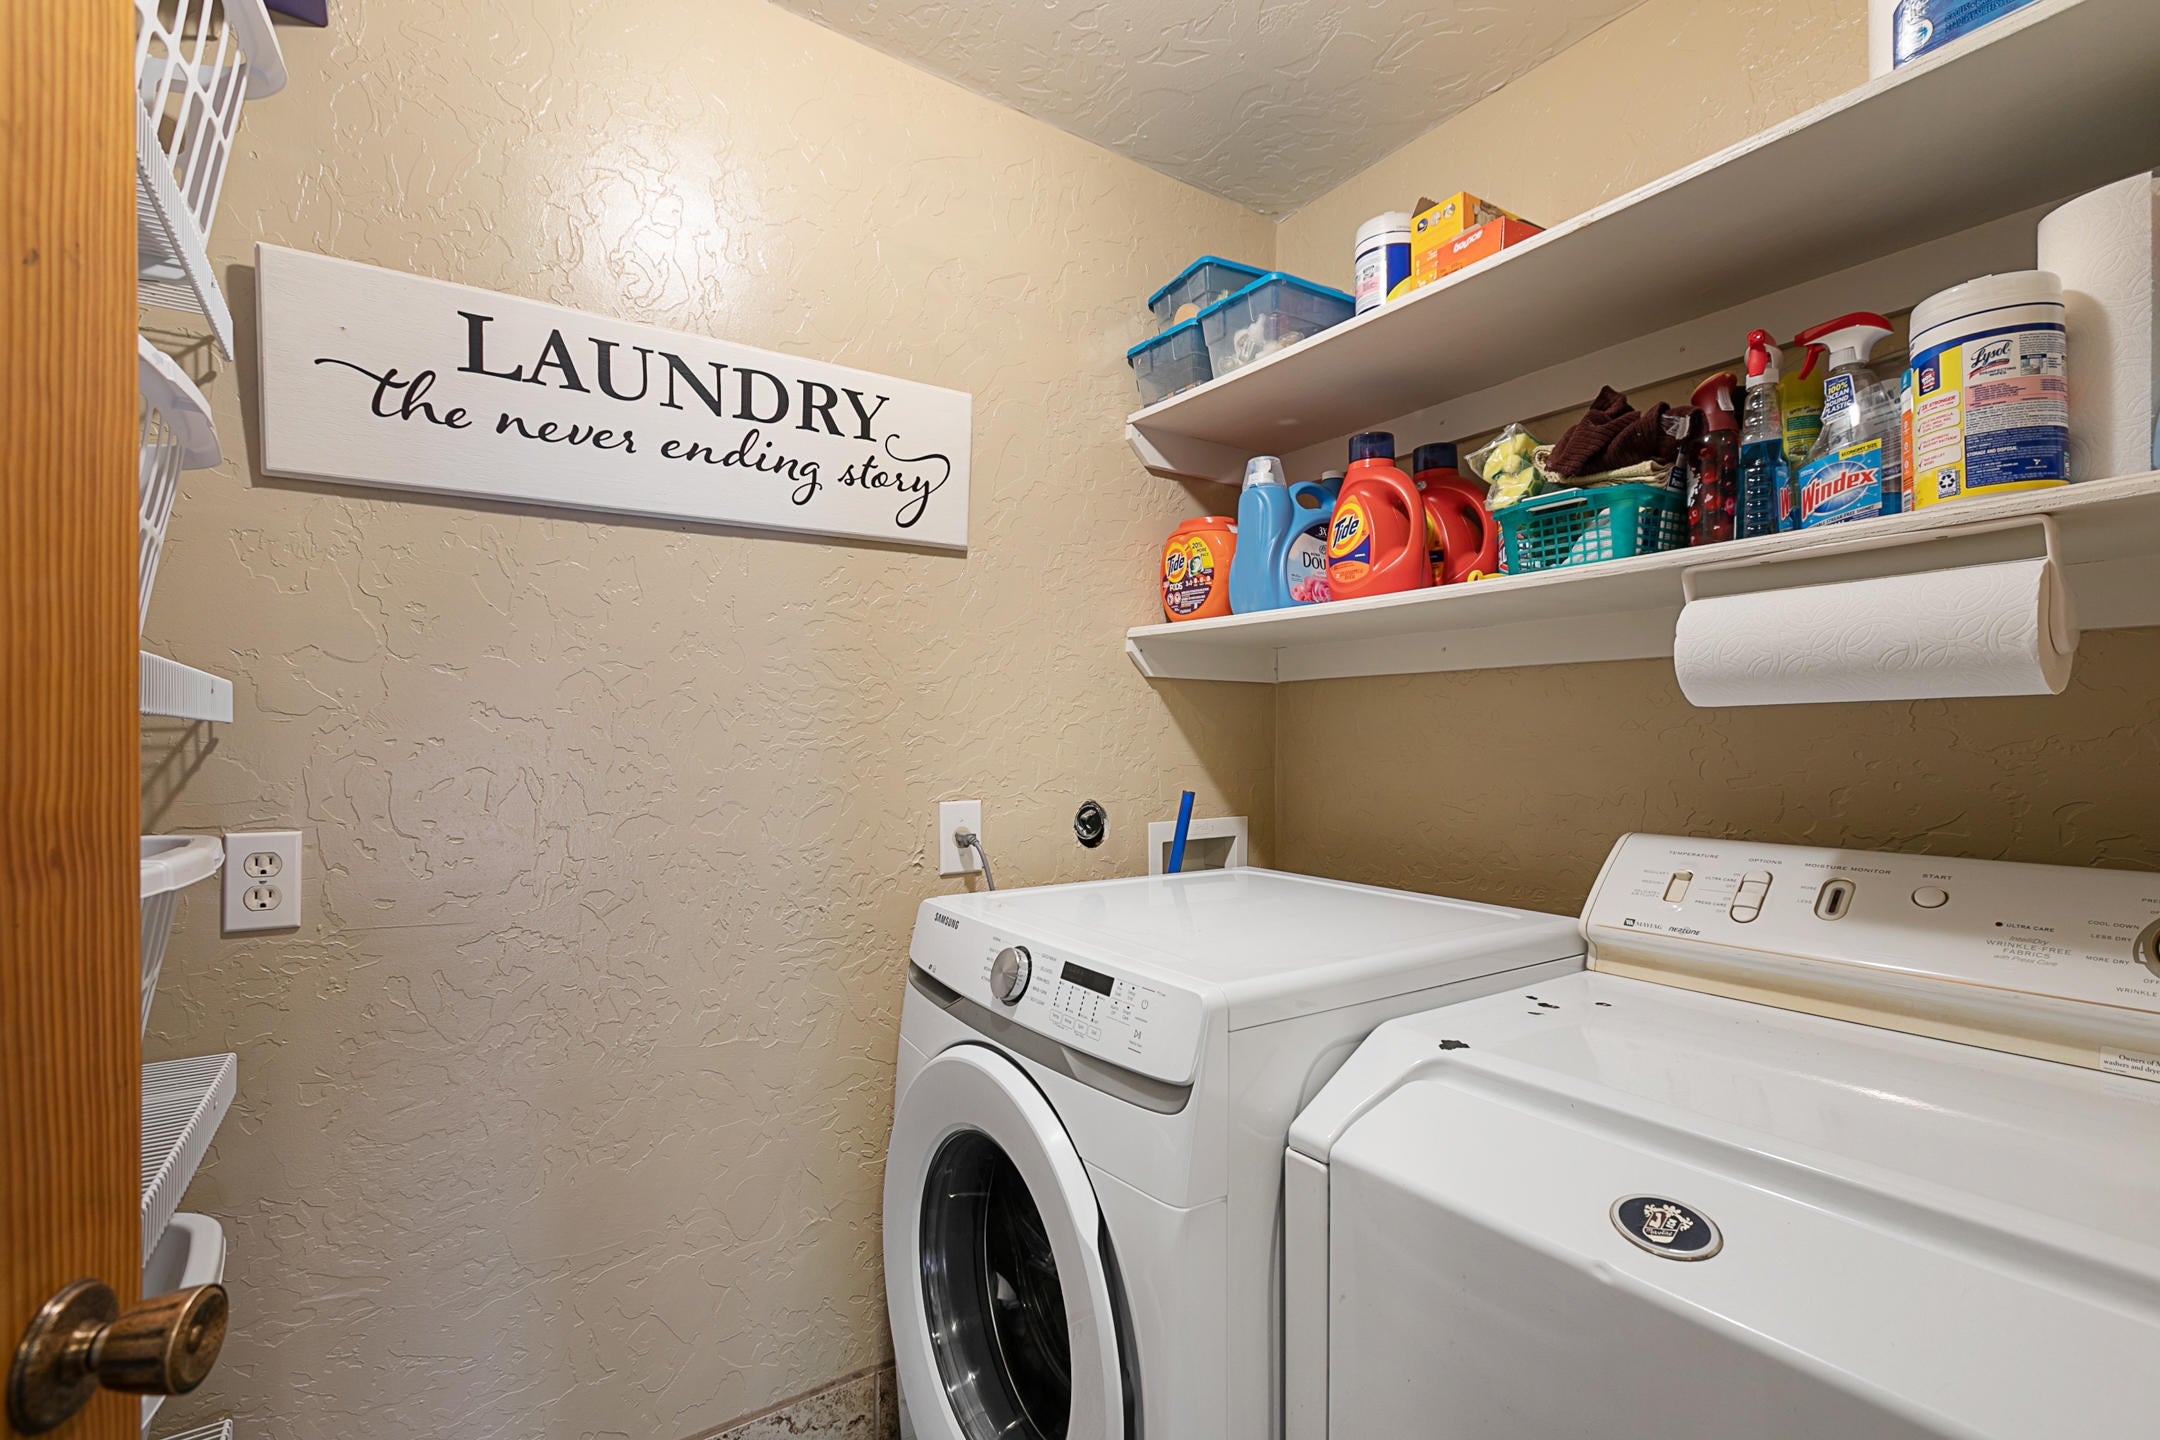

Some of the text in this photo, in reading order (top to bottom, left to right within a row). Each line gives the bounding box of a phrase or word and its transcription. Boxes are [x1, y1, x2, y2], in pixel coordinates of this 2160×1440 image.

[1971, 340, 2012, 368] Lysol
[457, 311, 890, 443] LAUNDRY
[1828, 380, 1848, 394] 100%
[1827, 388, 1850, 402] OCEAN
[314, 357, 951, 529] the never ending story
[1801, 470, 1878, 522] Windex
[1333, 516, 1360, 549] Tide
[1167, 553, 1185, 578] Tide
[1669, 850, 1720, 859] TEMPERATURE
[1804, 863, 1892, 875] MOISTURE MONITOR
[934, 912, 960, 930] SAMSUNG
[2006, 922, 2031, 930] ULTRA
[1985, 939, 2072, 956] WRINKLE-FREE
[2002, 948, 2050, 959] FABRICS
[2116, 986, 2158, 997] WRINKLE
[2104, 1060, 2129, 1069] washers
[2118, 1055, 2145, 1064] Owners
